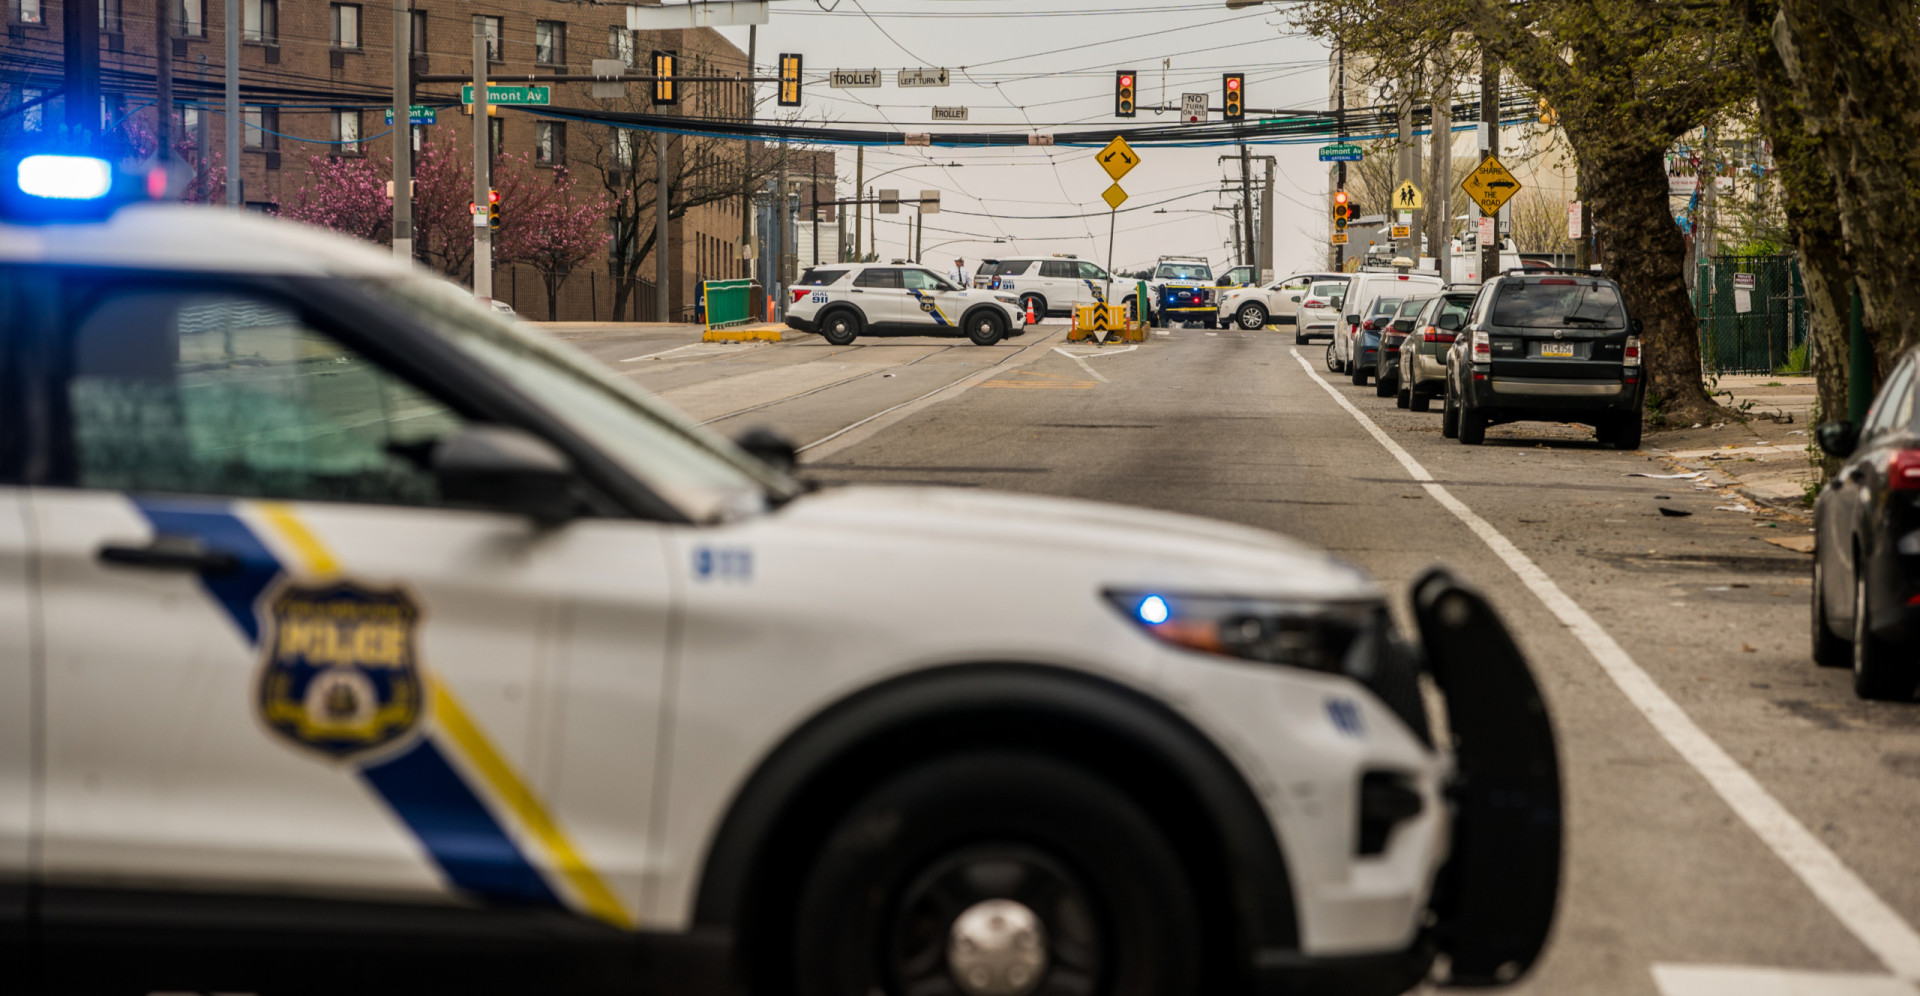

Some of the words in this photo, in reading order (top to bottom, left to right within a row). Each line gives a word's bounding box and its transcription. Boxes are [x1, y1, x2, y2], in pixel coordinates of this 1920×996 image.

[834, 74, 876, 85] TROLLEY
[527, 90, 542, 101] Av
[424, 109, 434, 117] Av
[935, 110, 965, 118] TROLLEY
[1479, 167, 1503, 175] SHARE
[278, 620, 408, 667] POLICE
